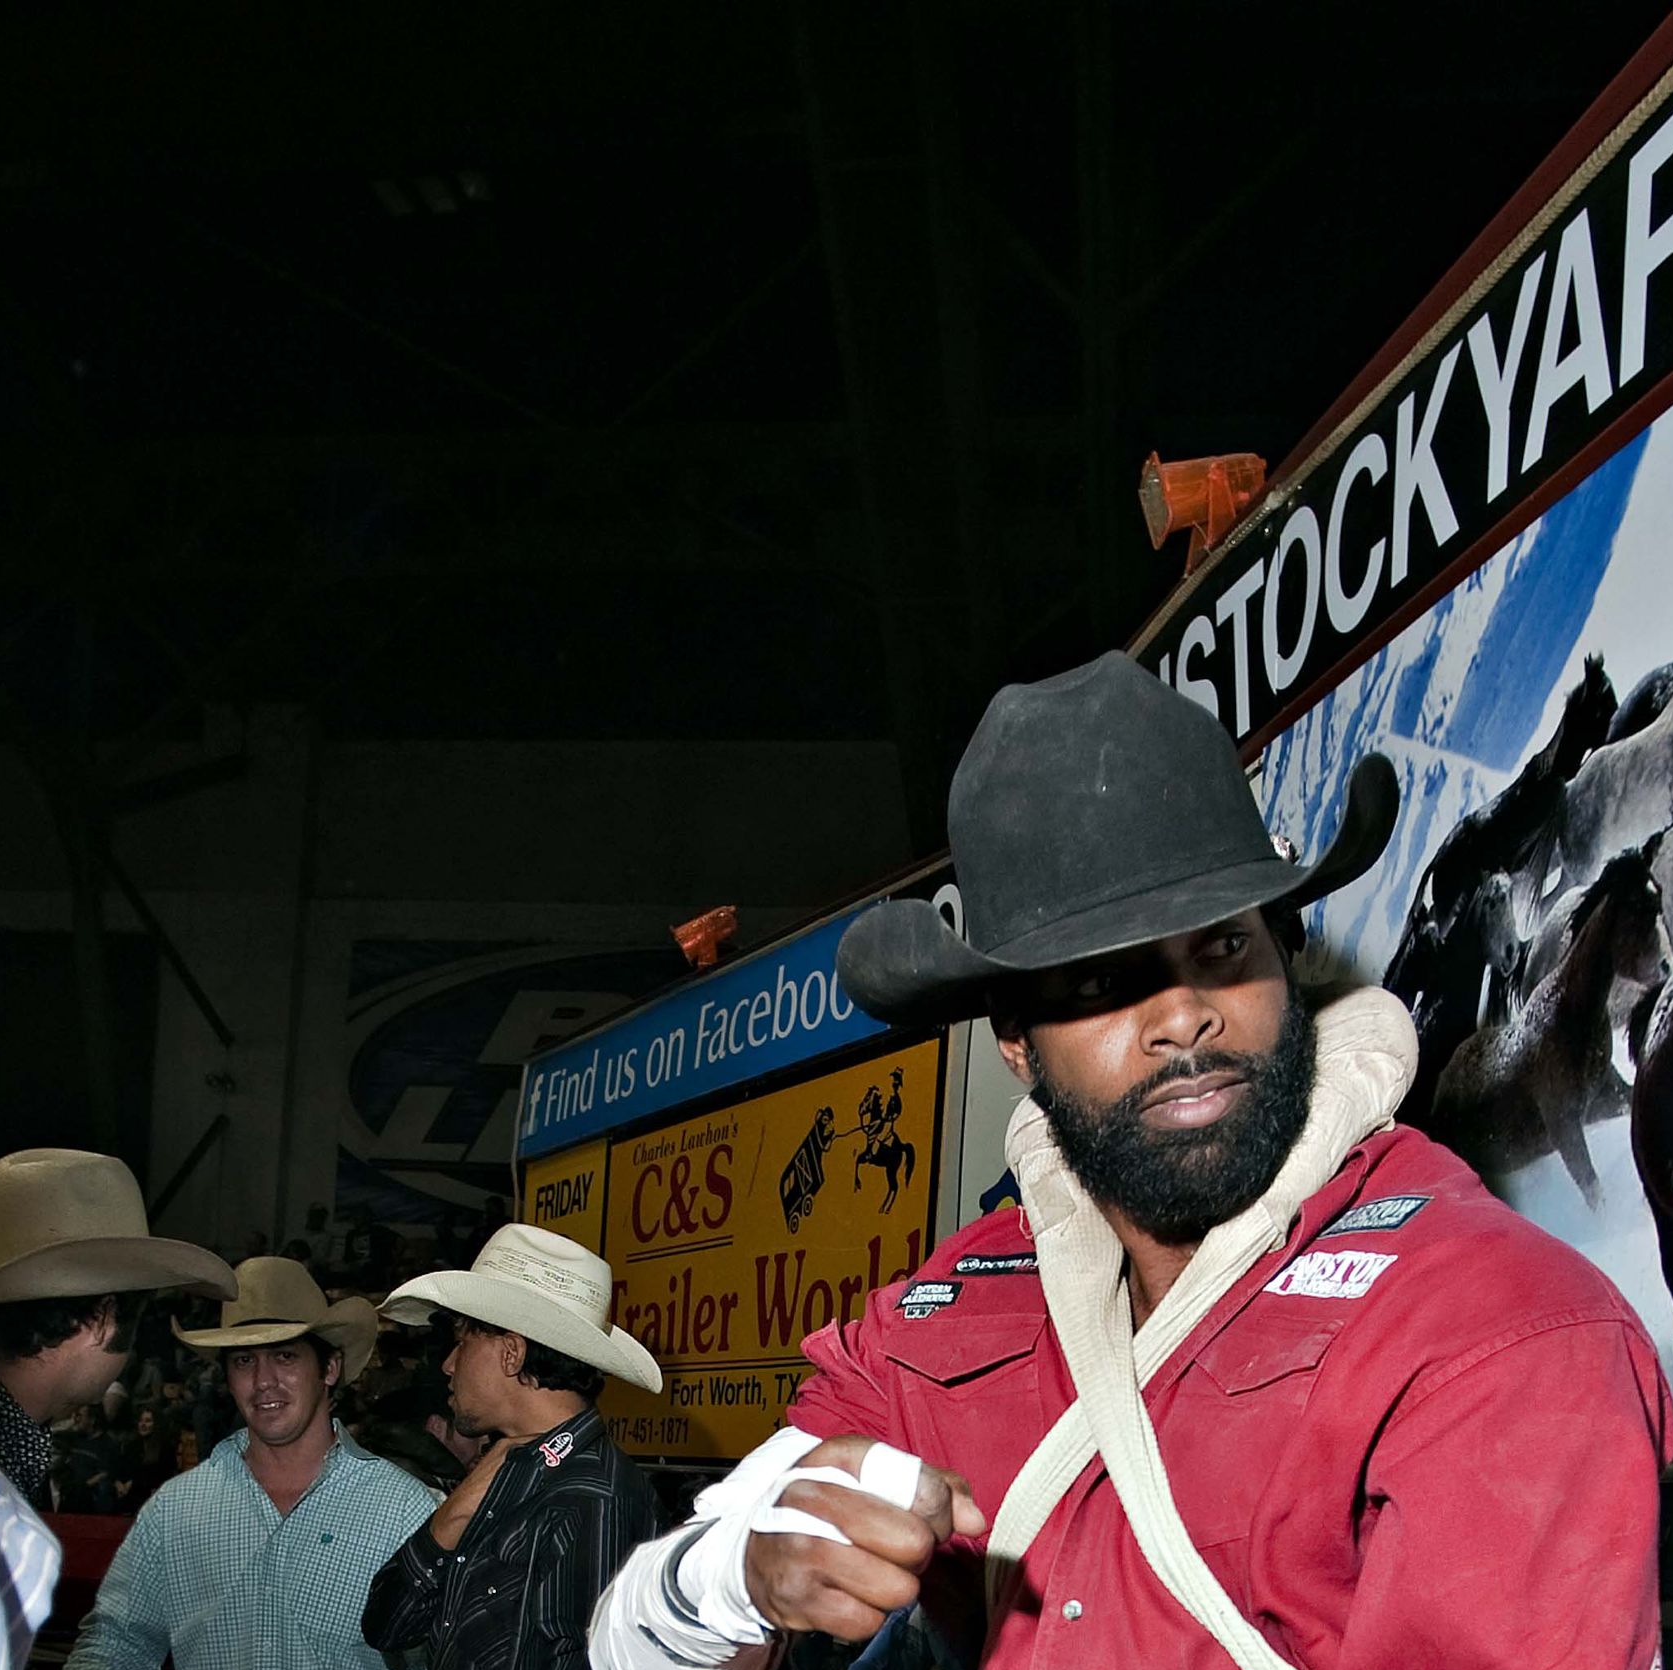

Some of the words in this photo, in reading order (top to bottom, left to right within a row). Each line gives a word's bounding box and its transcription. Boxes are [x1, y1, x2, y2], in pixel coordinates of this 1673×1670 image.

[544, 1048, 599, 1127] Find
[604, 1047, 638, 1104] us
[645, 1027, 686, 1088] on
[632, 1136, 676, 1167] Charles
[534, 1170, 595, 1225] FRIDAY
[631, 1144, 734, 1243] C&S
[610, 1266, 738, 1355] Trailer
[670, 1375, 706, 1407] Fort
[710, 1375, 767, 1411] Worth,
[775, 1373, 802, 1405] TX
